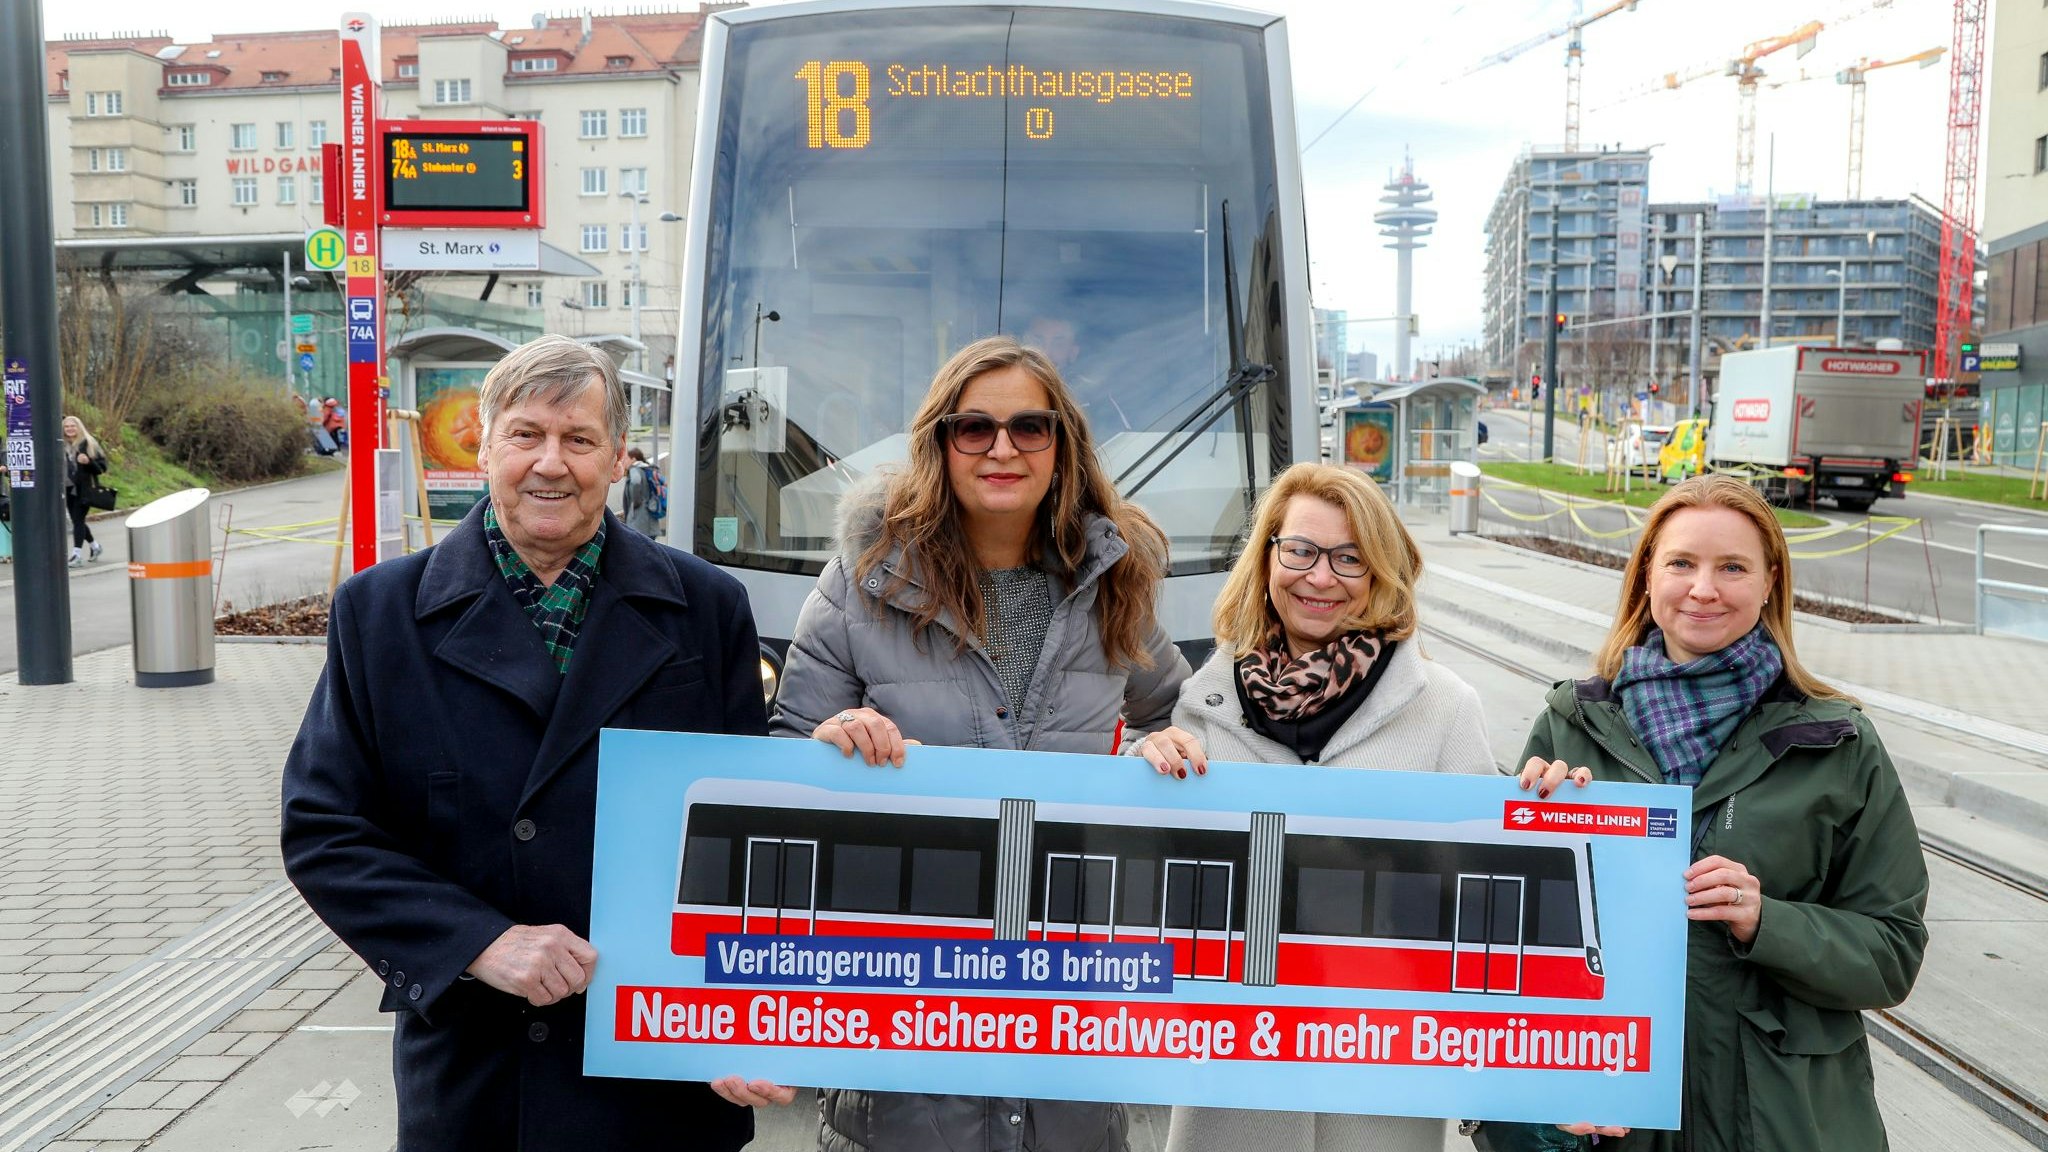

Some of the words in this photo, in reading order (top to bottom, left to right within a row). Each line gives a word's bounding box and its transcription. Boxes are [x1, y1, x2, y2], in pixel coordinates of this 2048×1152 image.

[350, 84, 365, 145] WIENER
[794, 60, 870, 148] 18
[888, 64, 1192, 103] Schlachthausgasse
[352, 149, 366, 200] LINIEN
[392, 159, 418, 179] 74A
[512, 159, 523, 180] 3
[316, 238, 336, 262] H
[419, 241, 440, 255] St.
[445, 242, 484, 255] Marx
[351, 260, 370, 273] 18
[350, 326, 374, 340] 74A
[1828, 360, 1894, 373] HOTWAGNER
[1965, 357, 1977, 371] P
[1541, 811, 1593, 824] WIENER
[1596, 814, 1641, 827] LINIEN
[717, 940, 920, 986] Verlängerung
[934, 945, 1006, 981] Linie
[1017, 949, 1049, 981] 18
[1063, 950, 1161, 991] bringt:
[631, 991, 735, 1040] Neue
[748, 995, 880, 1051] Gleise,
[892, 1001, 1037, 1048] sichere
[1051, 1005, 1235, 1064] Radwege
[1249, 1010, 1281, 1057] &
[1296, 1014, 1399, 1060] mehr
[1412, 1015, 1638, 1076] Begrünung!
